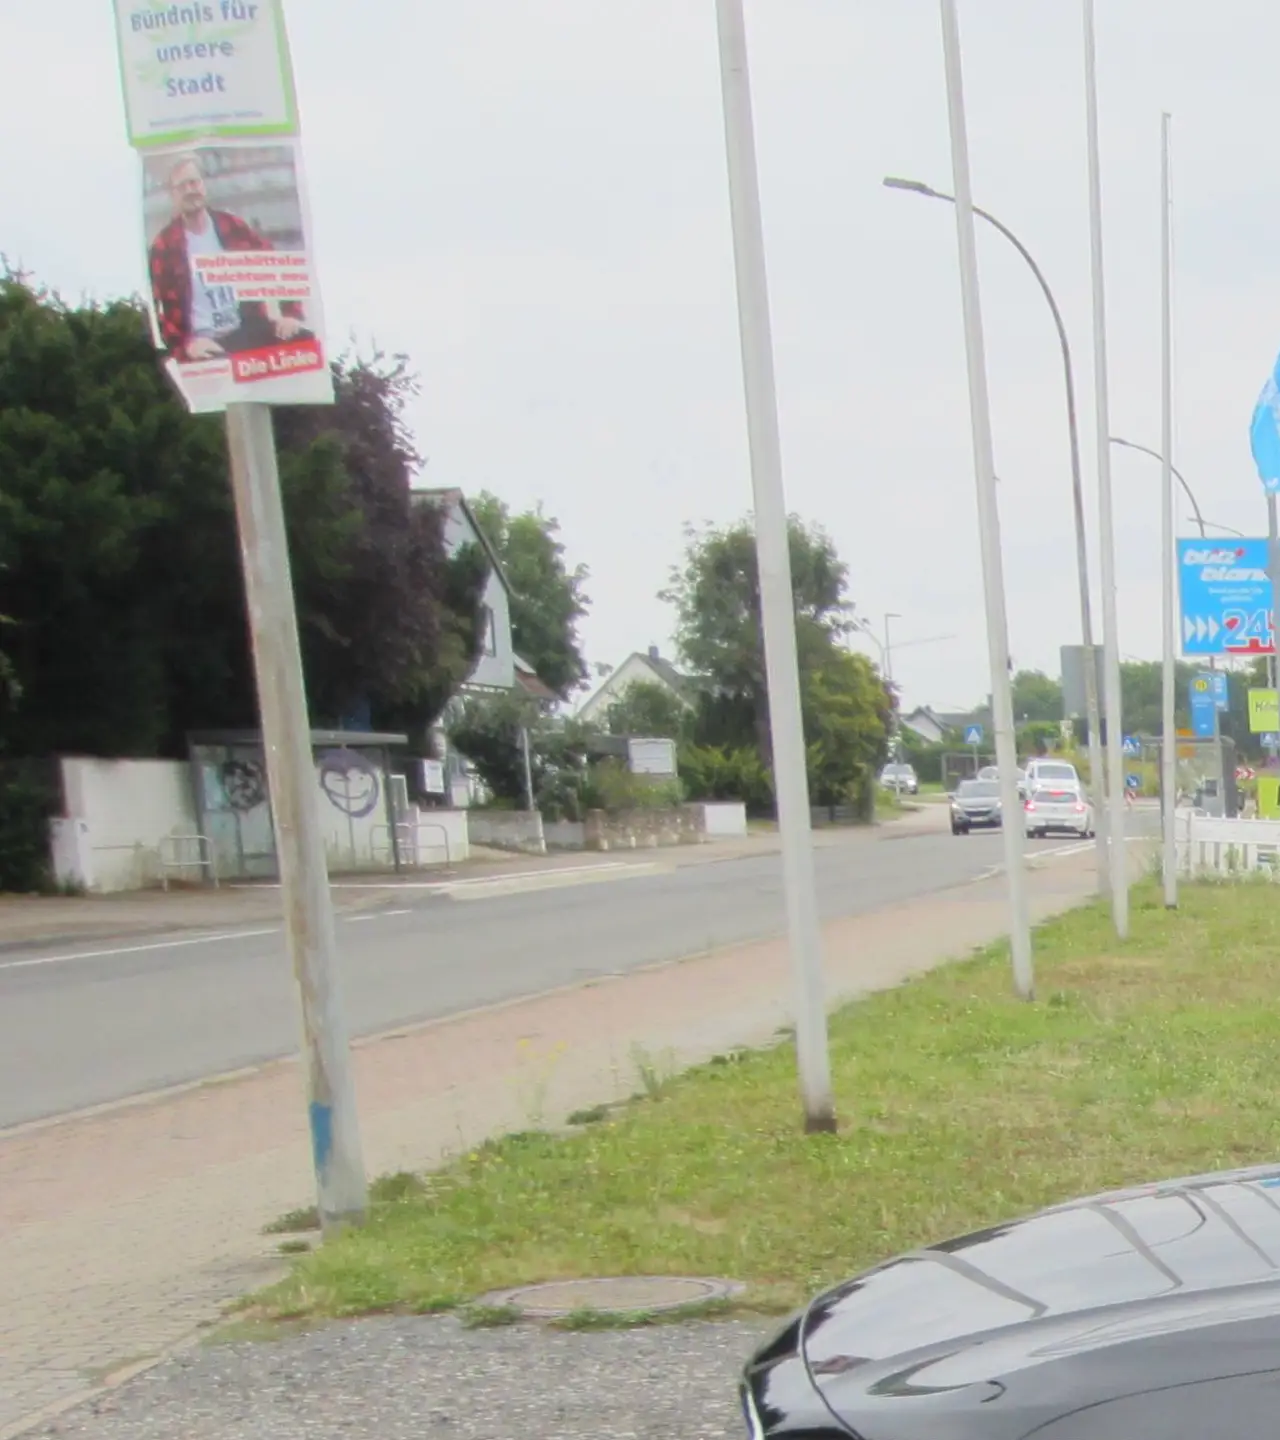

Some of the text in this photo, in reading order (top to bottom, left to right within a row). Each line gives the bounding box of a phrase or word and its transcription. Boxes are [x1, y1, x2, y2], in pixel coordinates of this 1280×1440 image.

[130, 0, 258, 32] Bündnis für
[156, 40, 235, 64] unsere
[165, 72, 226, 97] Stadt
[238, 357, 268, 377] Die
[268, 348, 318, 371] Linke
